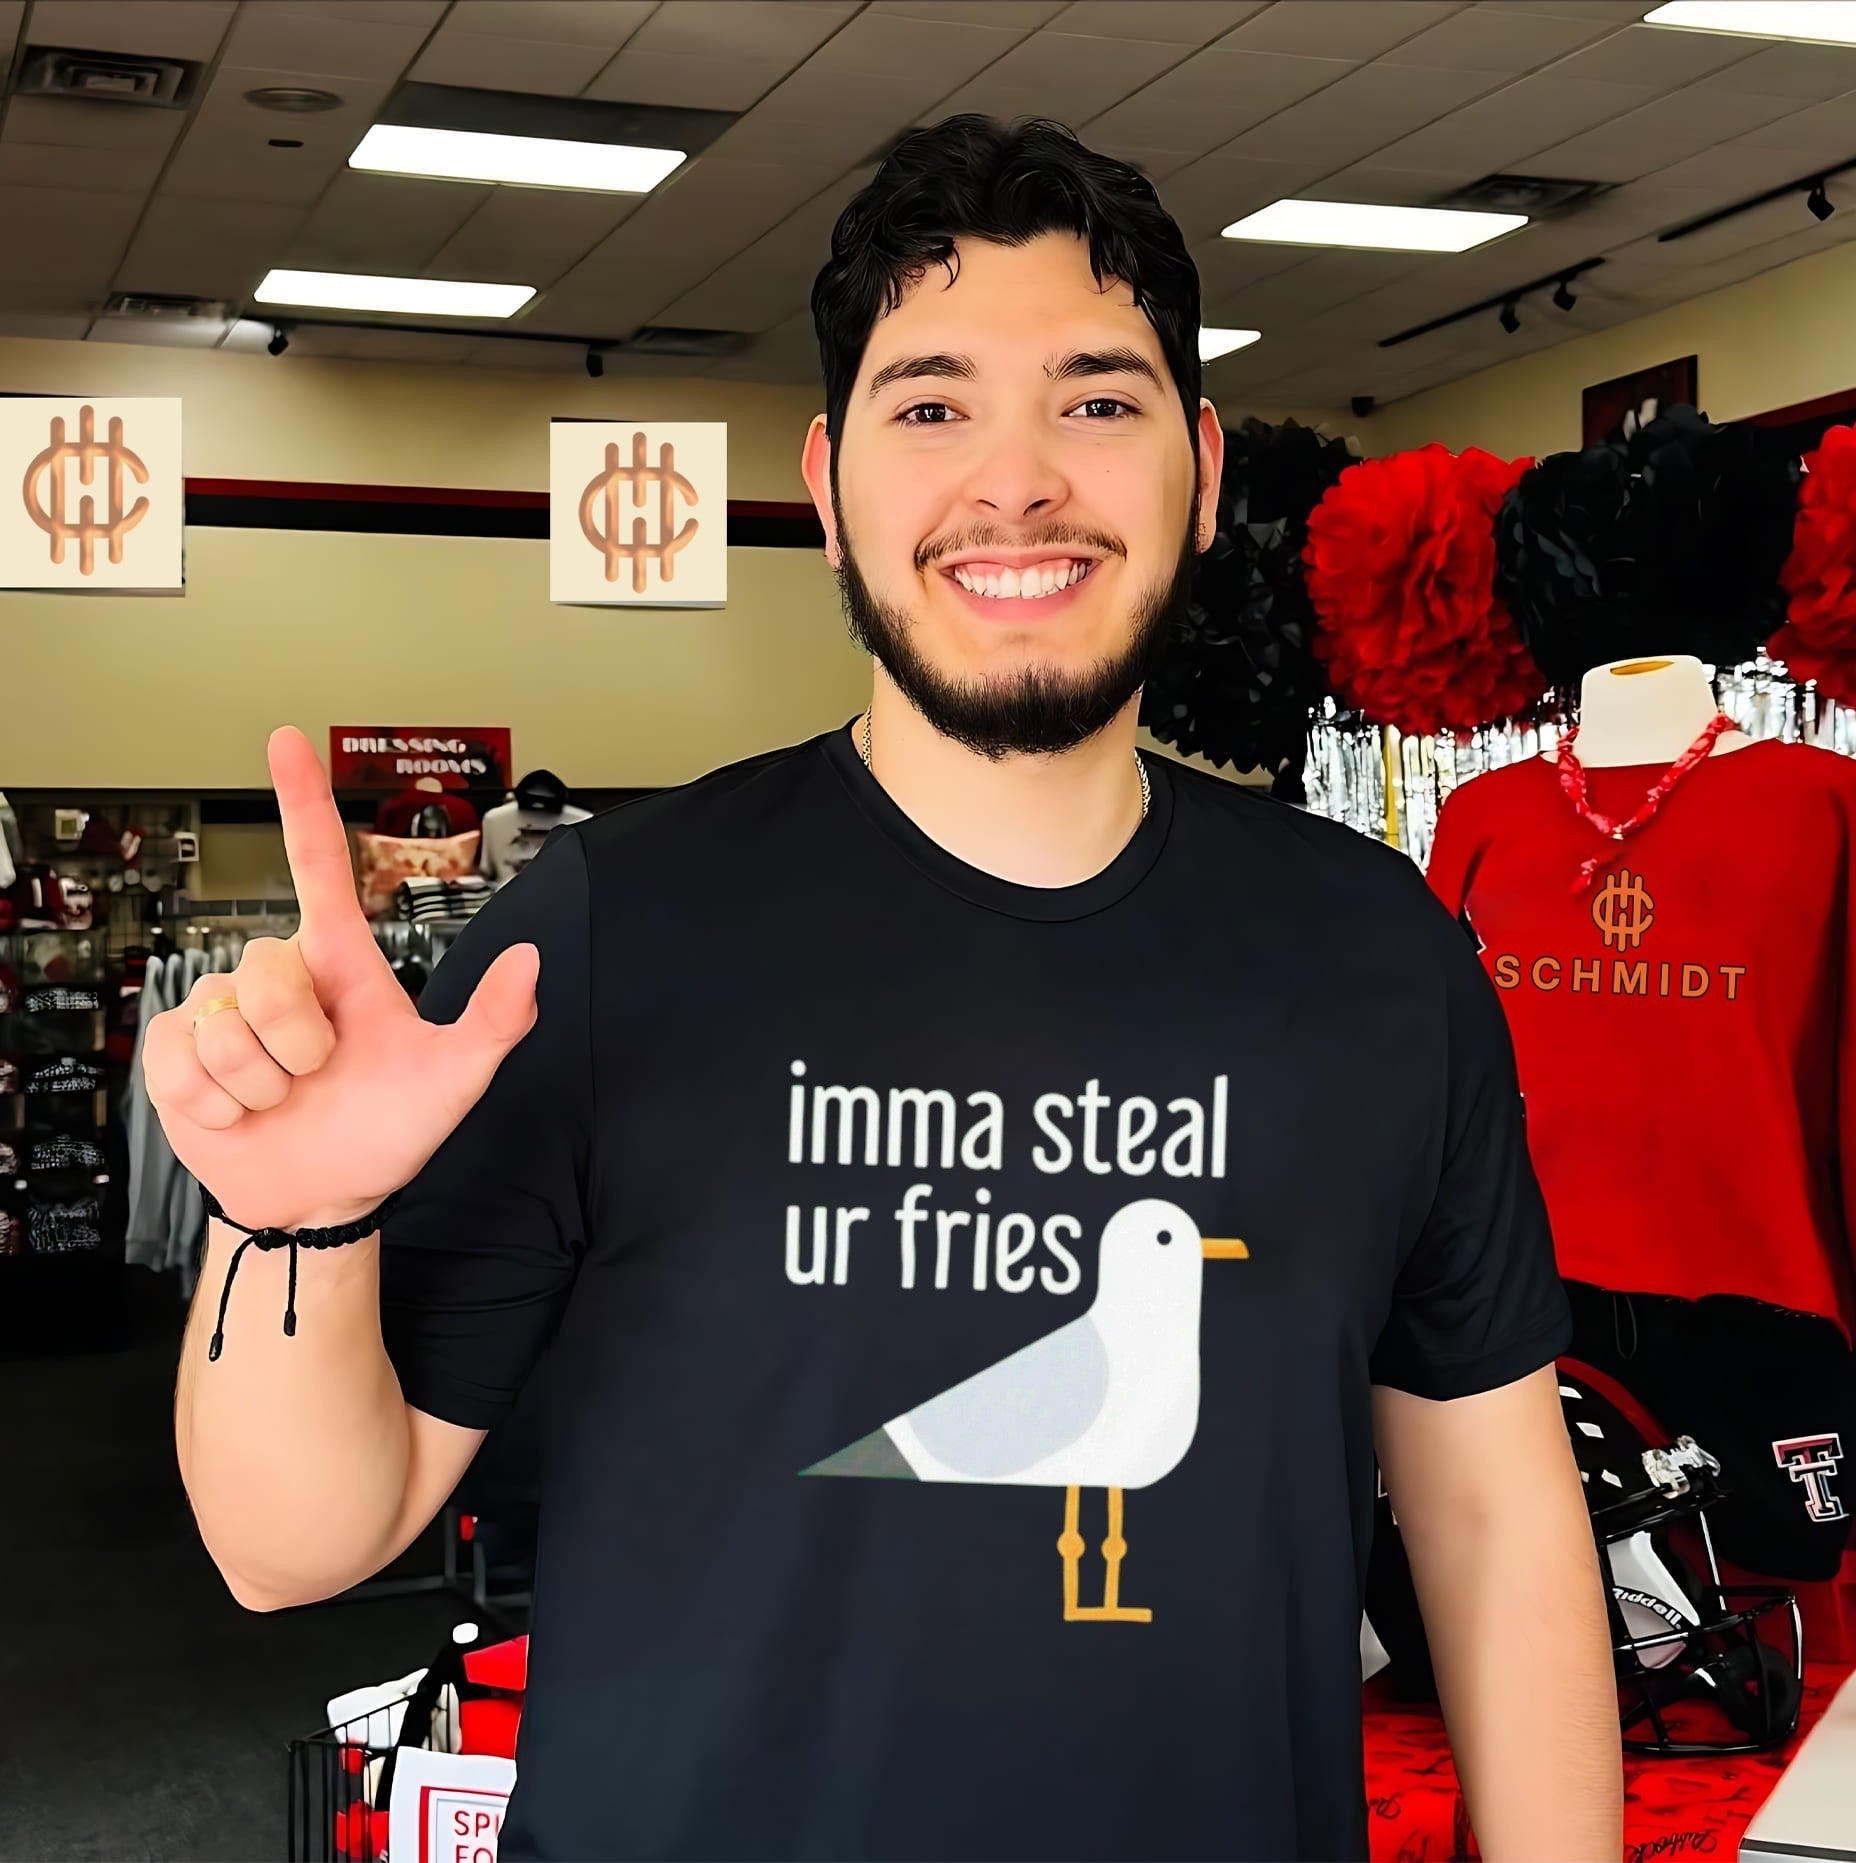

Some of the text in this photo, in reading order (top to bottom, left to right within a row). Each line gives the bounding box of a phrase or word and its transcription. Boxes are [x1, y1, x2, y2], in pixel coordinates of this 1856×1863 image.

[396, 758, 487, 775] ROOMS
[1494, 954, 1746, 1000] SCHMIDT
[788, 1059, 1229, 1178] imma steal
[785, 1183, 1083, 1295] ur fries
